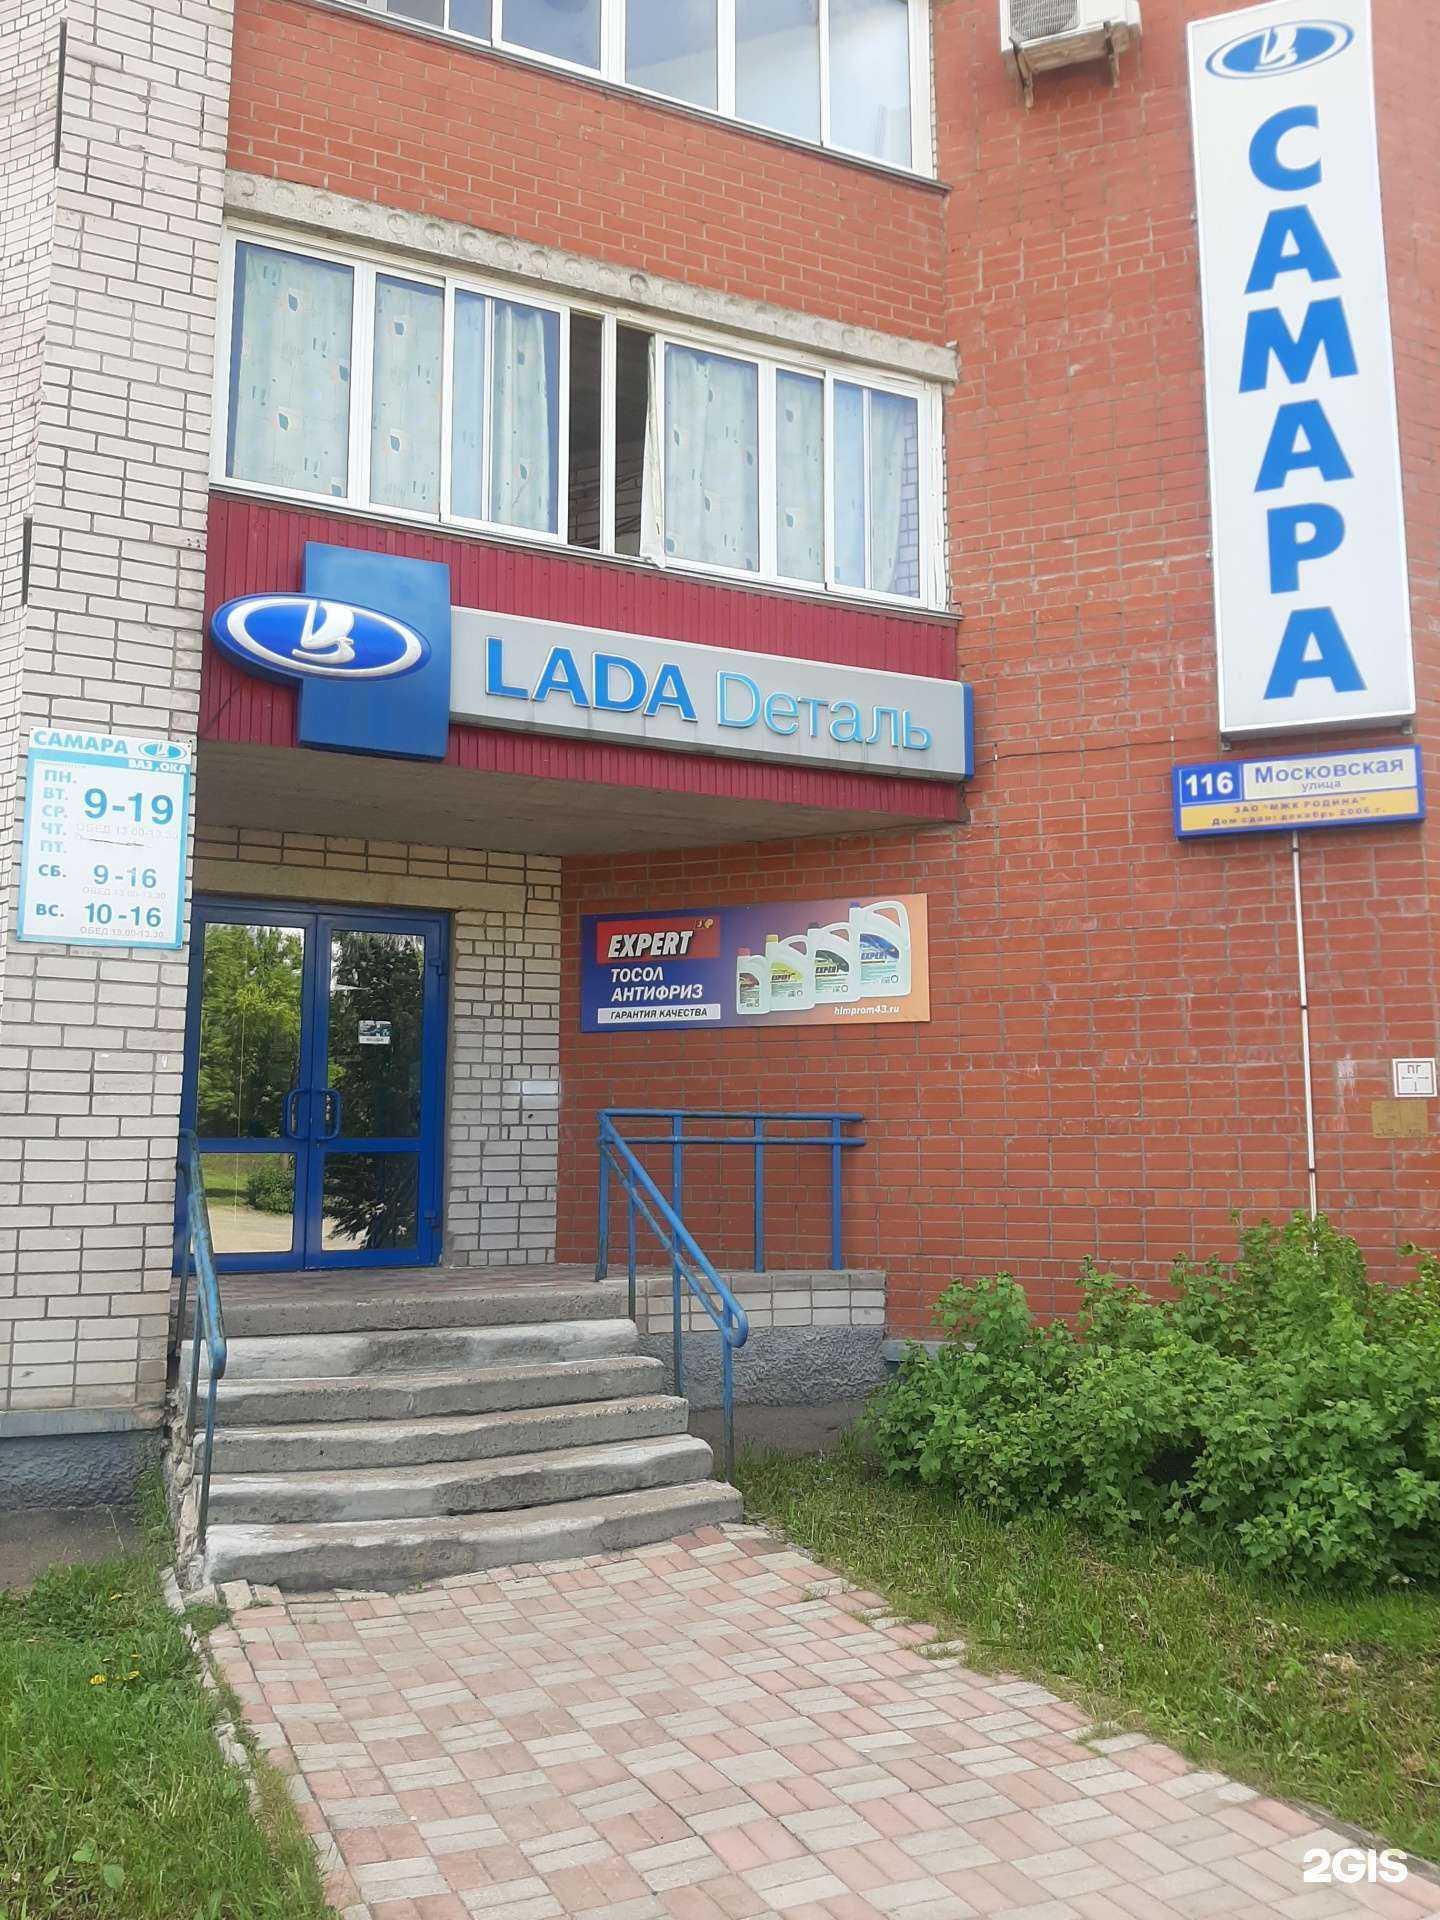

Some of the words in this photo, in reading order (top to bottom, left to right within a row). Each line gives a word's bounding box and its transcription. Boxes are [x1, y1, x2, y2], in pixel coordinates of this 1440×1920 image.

[1238, 104, 1368, 702] САМАРА
[485, 635, 698, 723] LADA
[34, 731, 129, 754] САМАРА
[44, 770, 77, 784] ПН.
[1254, 758, 1404, 784] Московская
[1185, 771, 1234, 797] 116
[1301, 779, 1342, 793] улица
[43, 787, 68, 800] ВТ.
[42, 804, 68, 818] СР.
[84, 788, 174, 826] 9-19
[41, 822, 67, 836] ЧТ.
[40, 840, 67, 853] ПТ.
[38, 864, 67, 878] СБ.
[35, 903, 65, 917] ВС.
[84, 902, 162, 928] 10-16
[608, 930, 694, 958] EXPERT
[611, 967, 664, 983] ТОСОЛ
[611, 984, 703, 1002] АНТИФРИЗ
[611, 1009, 657, 1019] ГАРАНТИЯ
[659, 1007, 708, 1018] КАЧЕСТВА
